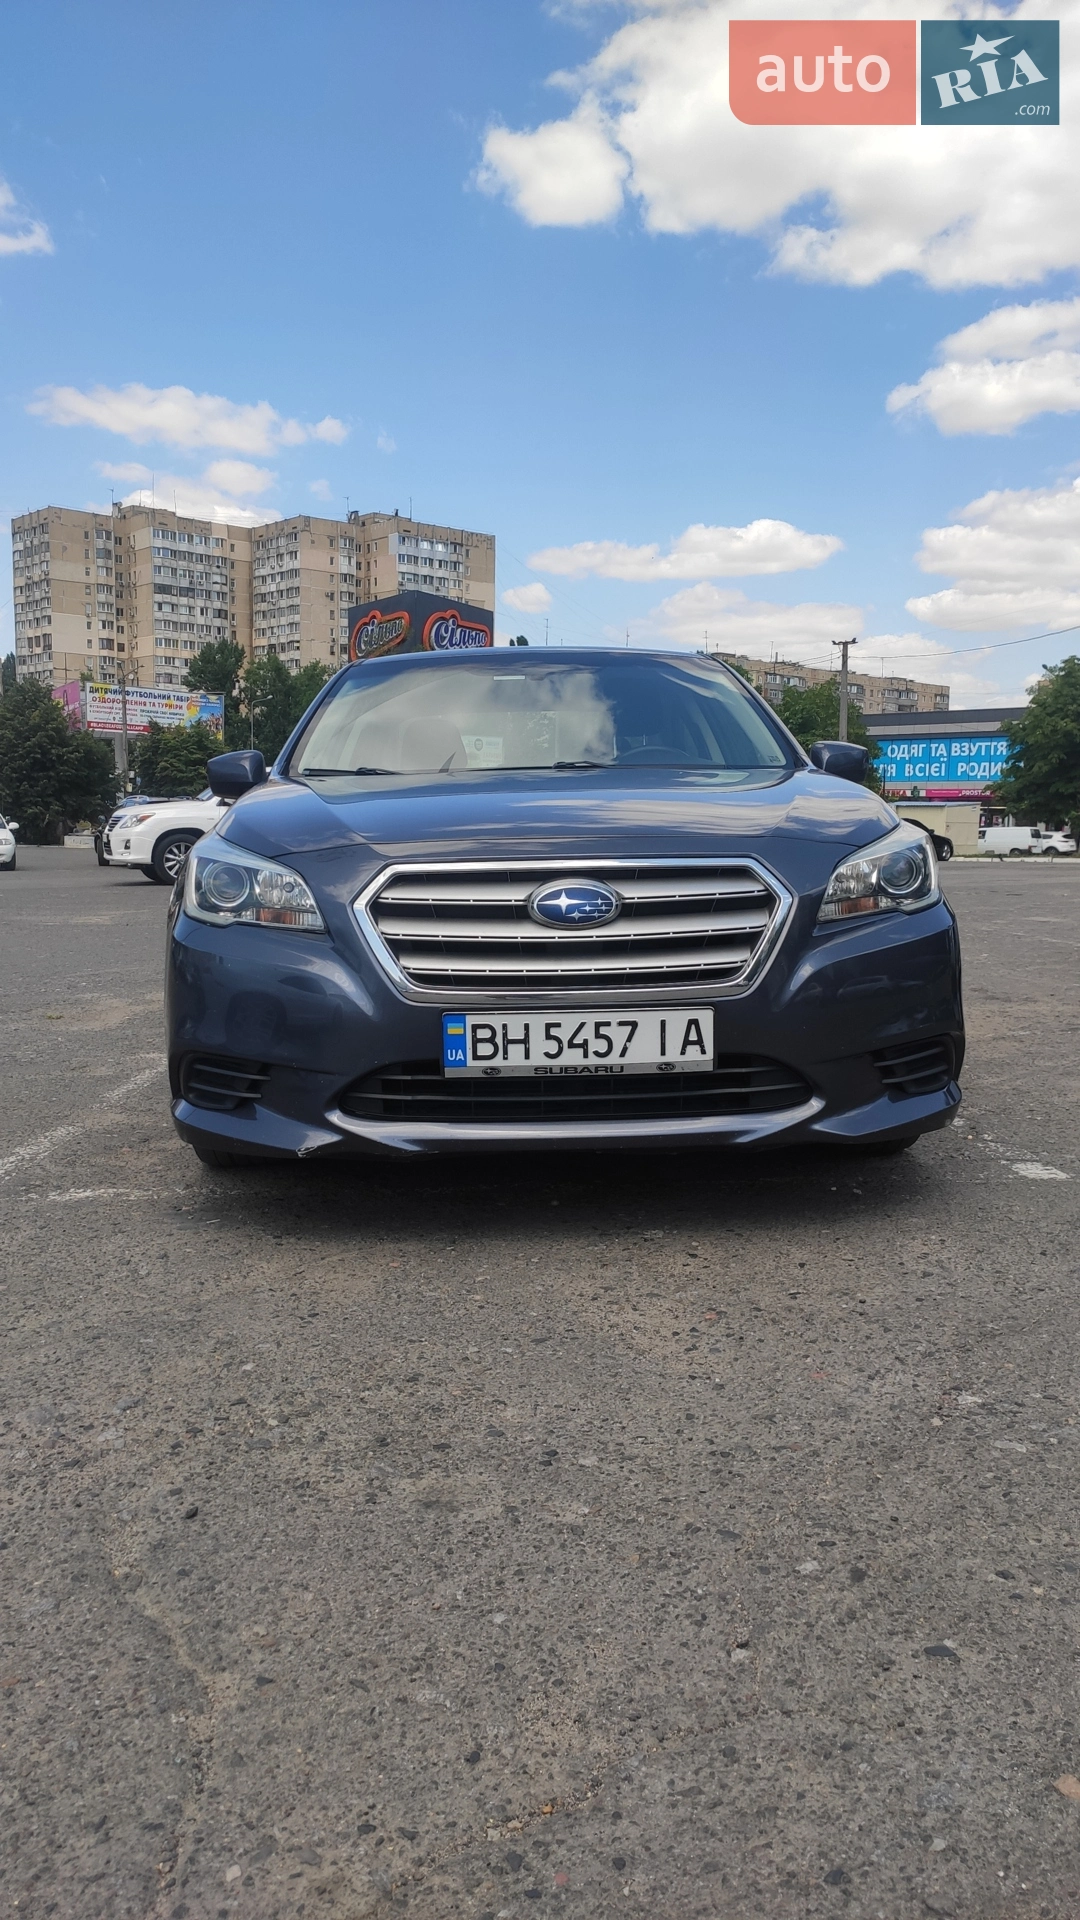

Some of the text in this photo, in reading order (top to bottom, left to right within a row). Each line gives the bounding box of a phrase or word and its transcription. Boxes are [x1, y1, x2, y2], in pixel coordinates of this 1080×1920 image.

[356, 618, 404, 657] Сільпо
[434, 618, 488, 650] Сільпо
[89, 686, 123, 696] ДИТЯЧИЙ
[125, 689, 171, 701] ФУТБОЛЬНИЙ
[91, 696, 147, 707] ОЗДОРОЛЕННЯ
[157, 702, 183, 710] ТУРНІРИ
[887, 741, 1007, 760] ОДЯГ ТА ВЗУТТЯ
[904, 757, 945, 777] ВСІЄЇ
[470, 1022, 530, 1061] BH
[543, 1019, 639, 1060] 5457
[447, 1049, 464, 1061] UA
[533, 1065, 625, 1075] SUBARU
